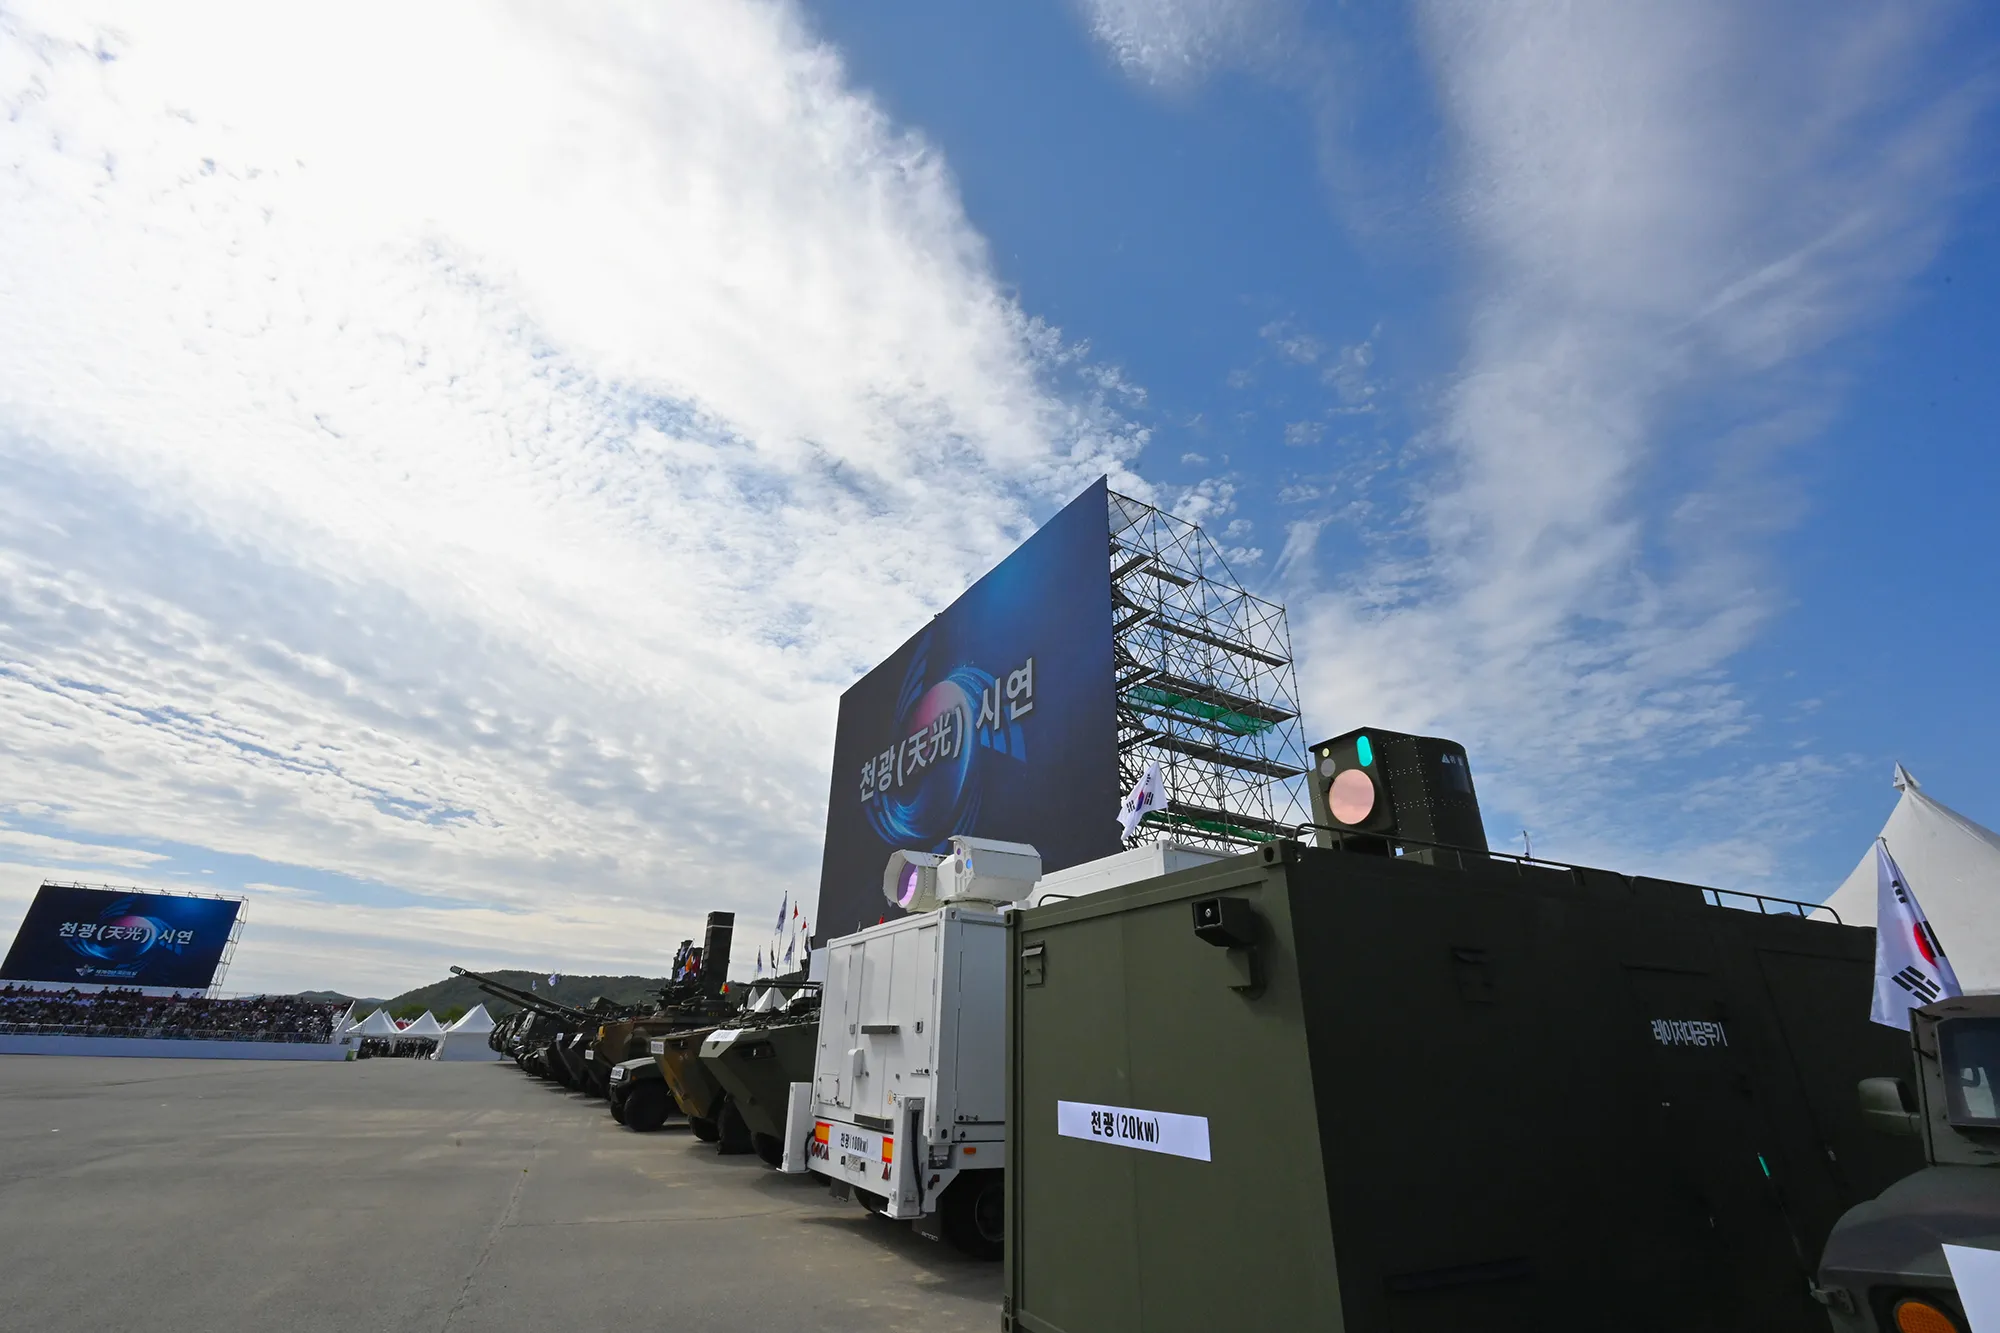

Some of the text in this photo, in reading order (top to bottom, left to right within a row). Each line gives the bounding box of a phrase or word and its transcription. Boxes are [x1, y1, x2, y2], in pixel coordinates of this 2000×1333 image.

[859, 657, 1033, 802] 천광(天光) 시연
[158, 929, 193, 945] 시연
[1651, 1019, 1728, 1046] 레이저대공무기
